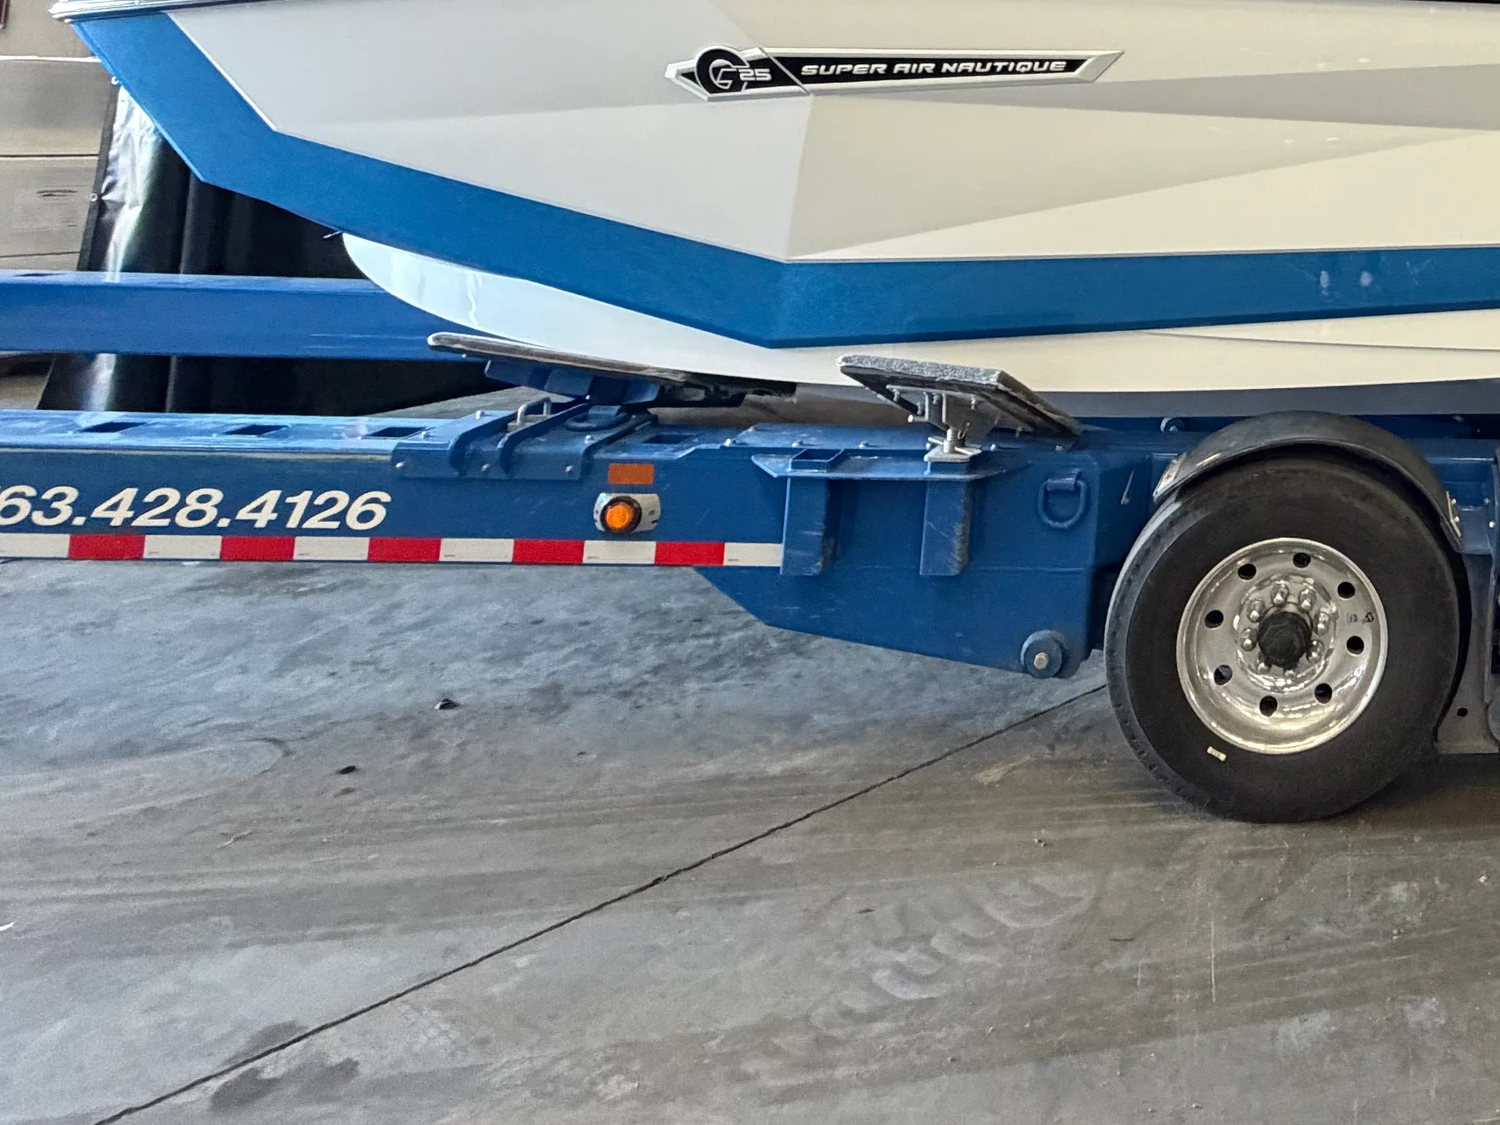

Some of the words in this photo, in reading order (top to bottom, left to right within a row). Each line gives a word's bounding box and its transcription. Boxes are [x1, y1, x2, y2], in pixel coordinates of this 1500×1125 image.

[801, 64, 887, 75] SUPER
[893, 63, 935, 74] AIR
[941, 61, 1066, 73] NAUTIQUE
[0, 484, 392, 530] 63.428.4126
